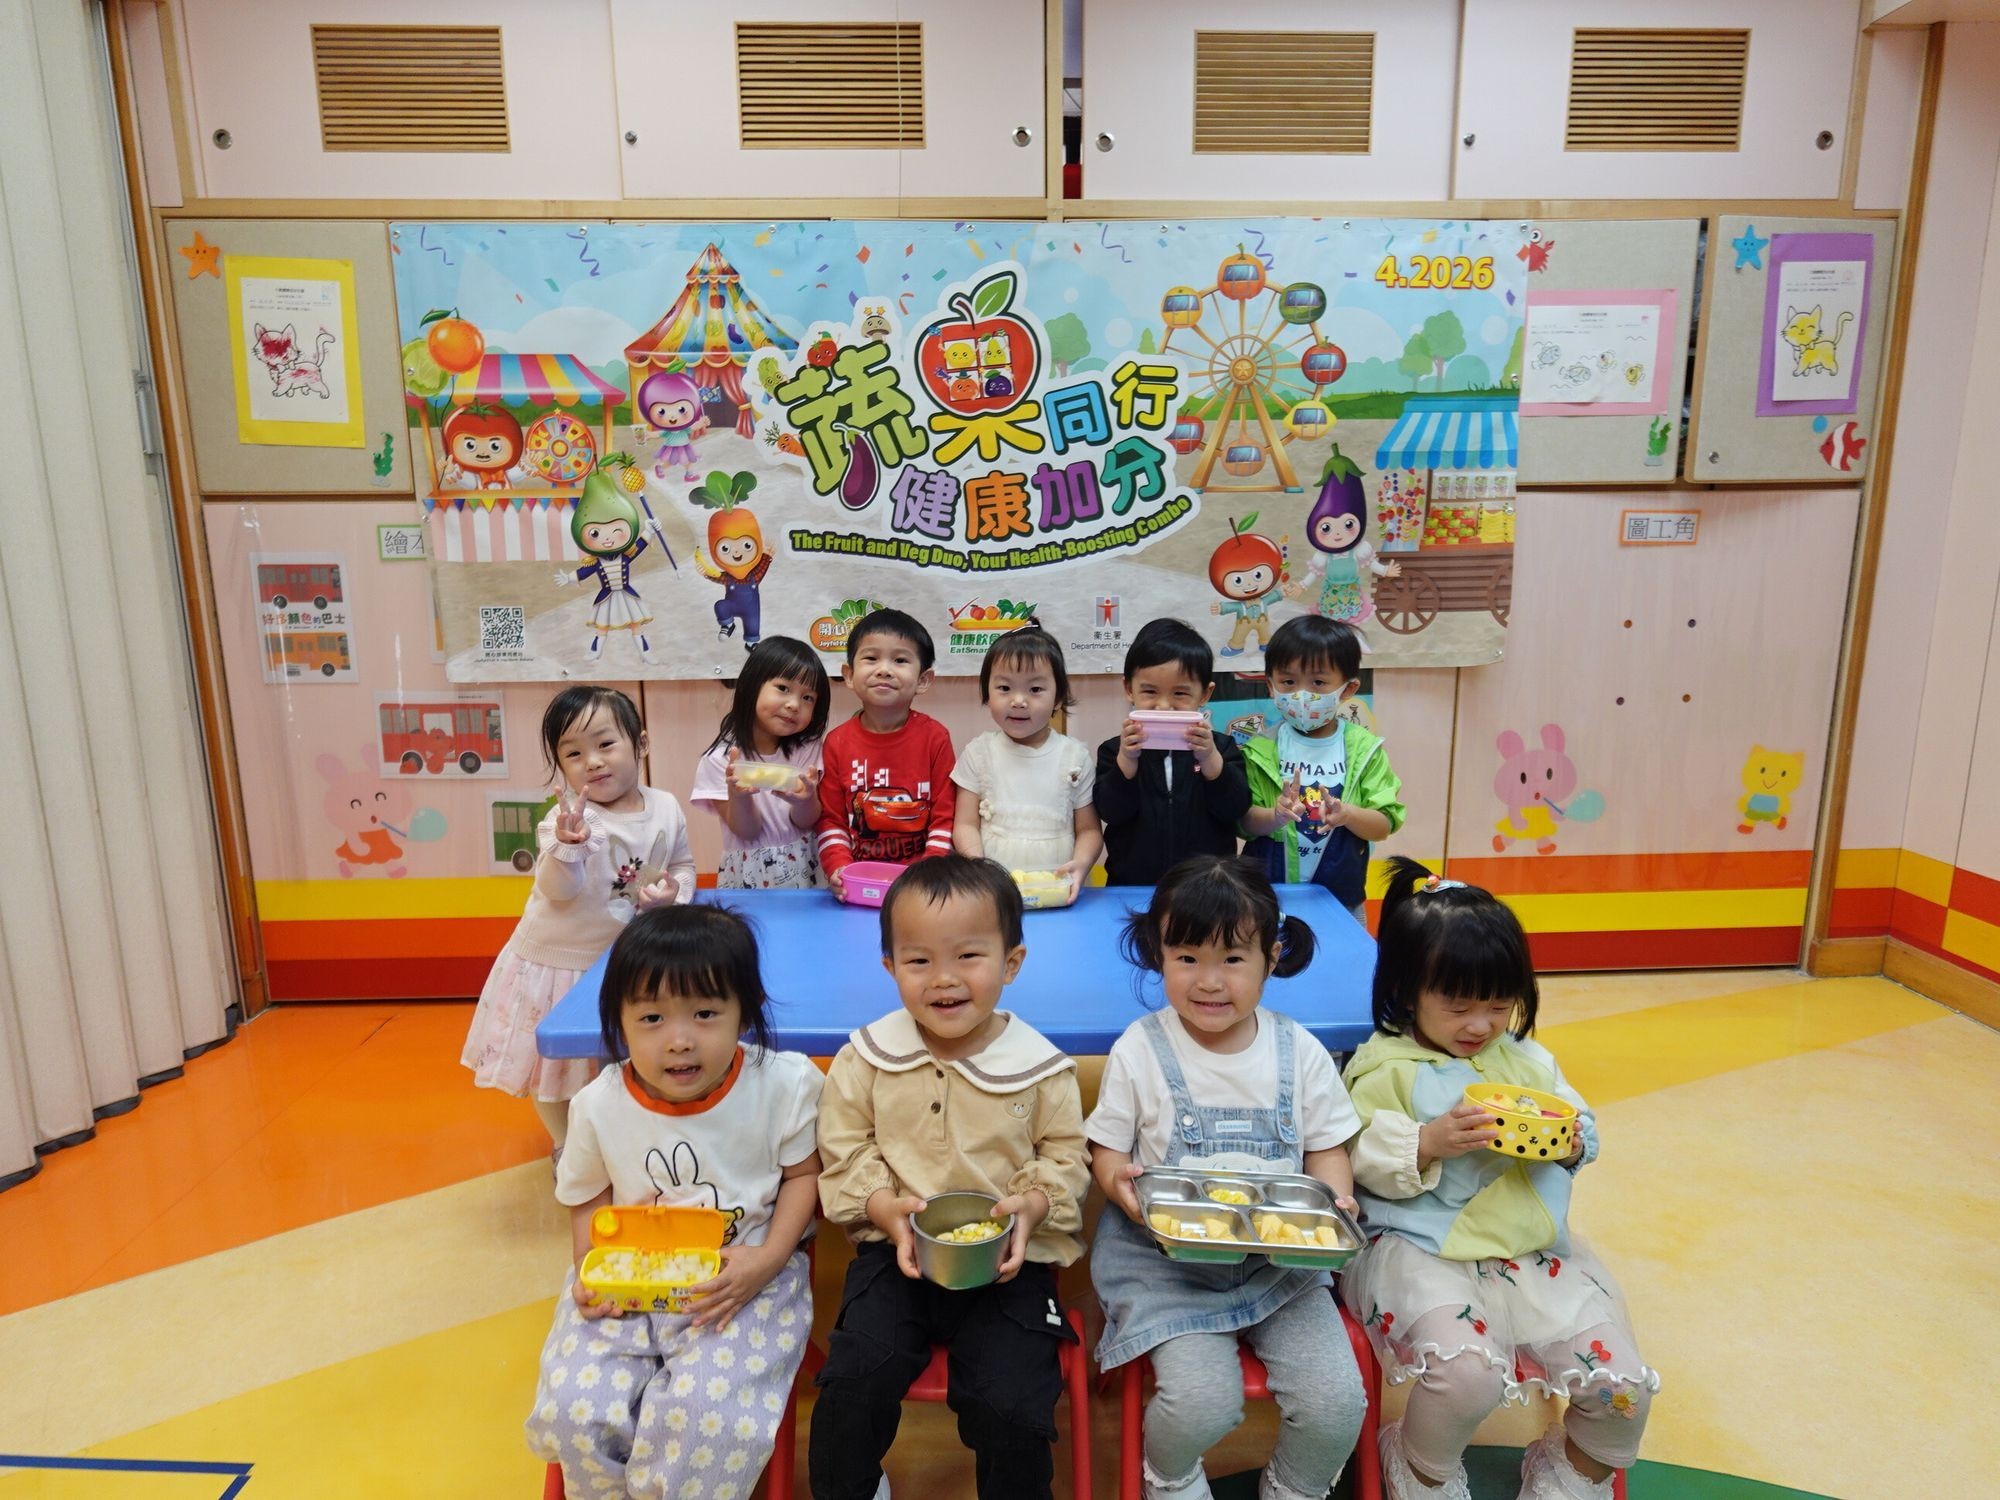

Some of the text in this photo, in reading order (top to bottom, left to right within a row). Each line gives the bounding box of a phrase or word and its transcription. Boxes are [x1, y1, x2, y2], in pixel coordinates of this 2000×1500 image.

[1375, 255, 1494, 289] 4.2026
[774, 315, 1179, 500] 蔬果同行
[890, 436, 1167, 543] 健康加分
[791, 497, 1190, 570] The Fruit and Veg Duo, Your Health-Boosting Combo
[1627, 516, 1696, 540] 圖工角
[818, 623, 848, 636] 開心
[950, 633, 1000, 646] 健康飲食
[1071, 642, 1112, 650] Department
[1113, 642, 1121, 650] of
[1280, 760, 1345, 776] HMAJI
